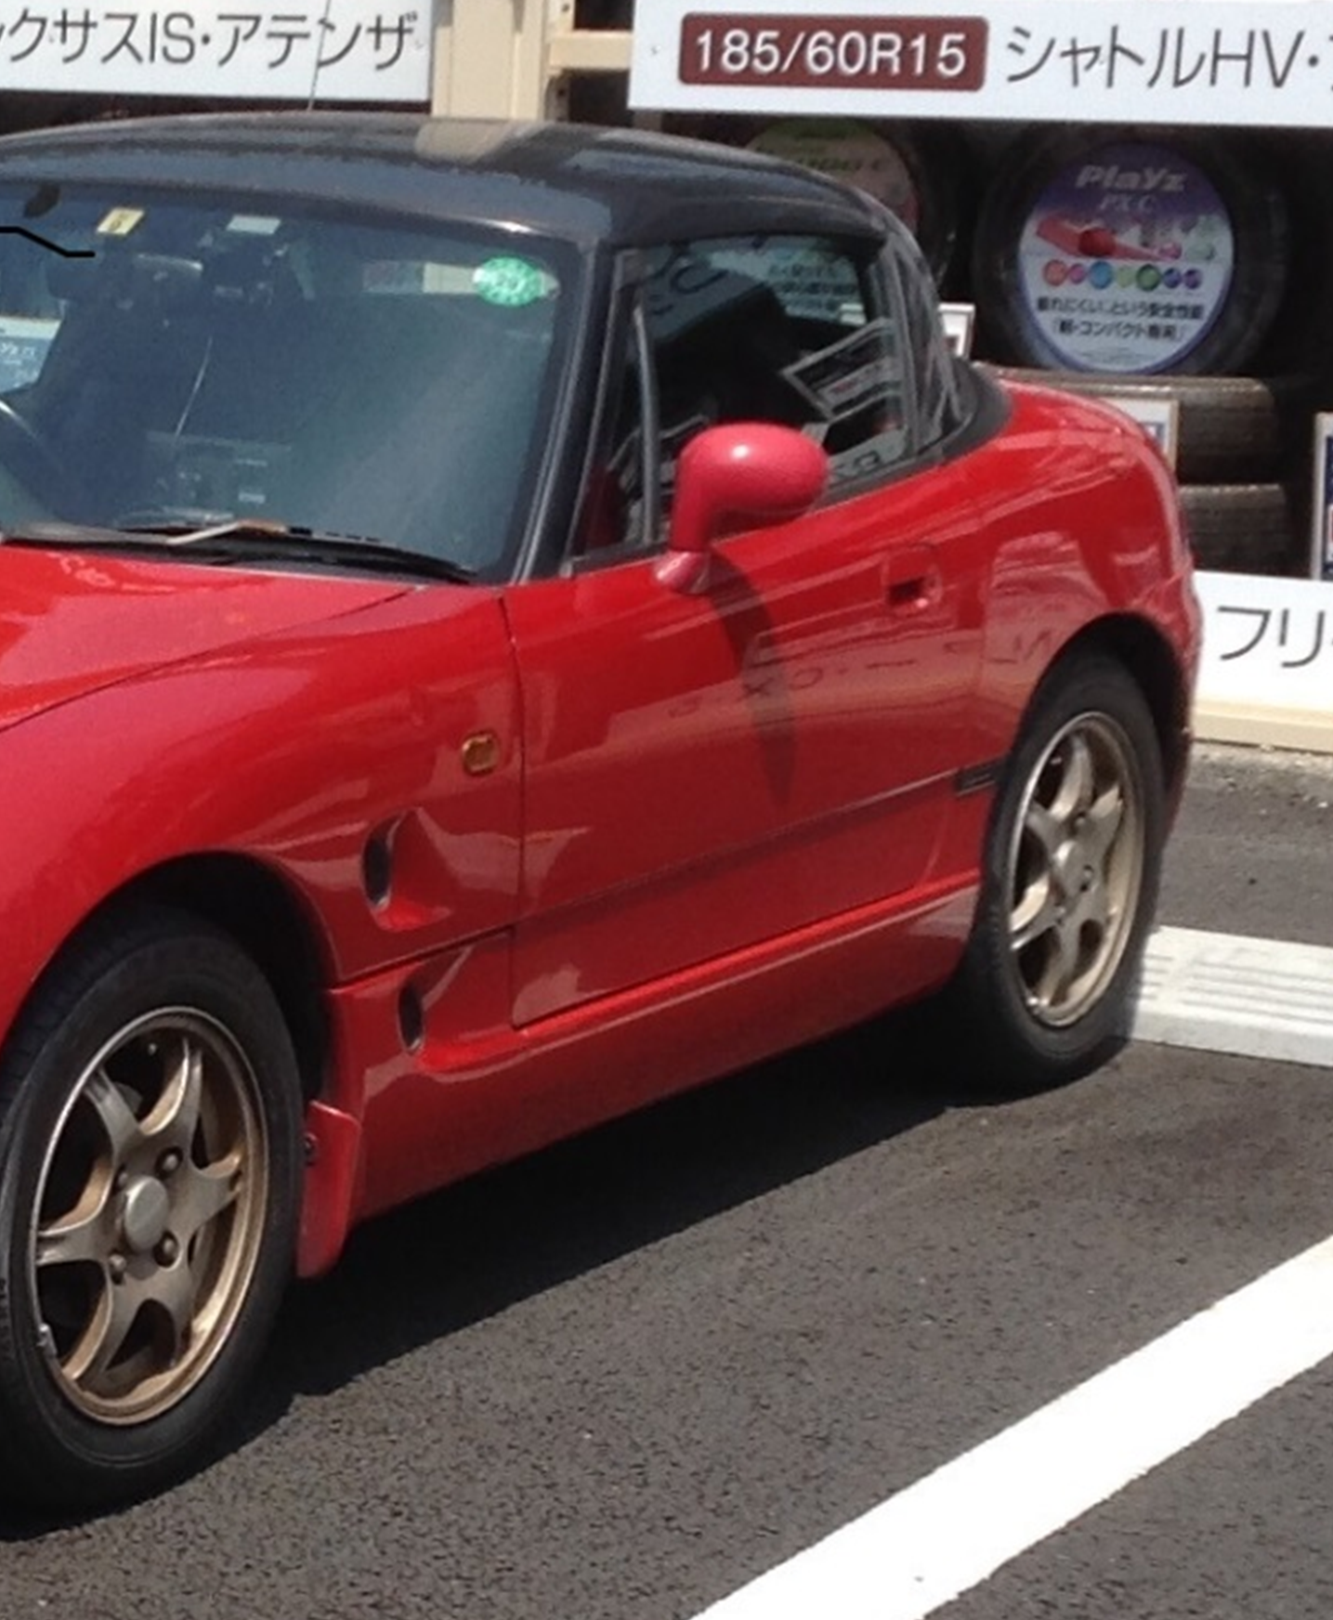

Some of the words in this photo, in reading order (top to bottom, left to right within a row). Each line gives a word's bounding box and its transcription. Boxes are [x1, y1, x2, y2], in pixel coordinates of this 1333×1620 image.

[696, 27, 967, 78] 185/60R15
[1006, 24, 1333, 90] シャトルHV・
